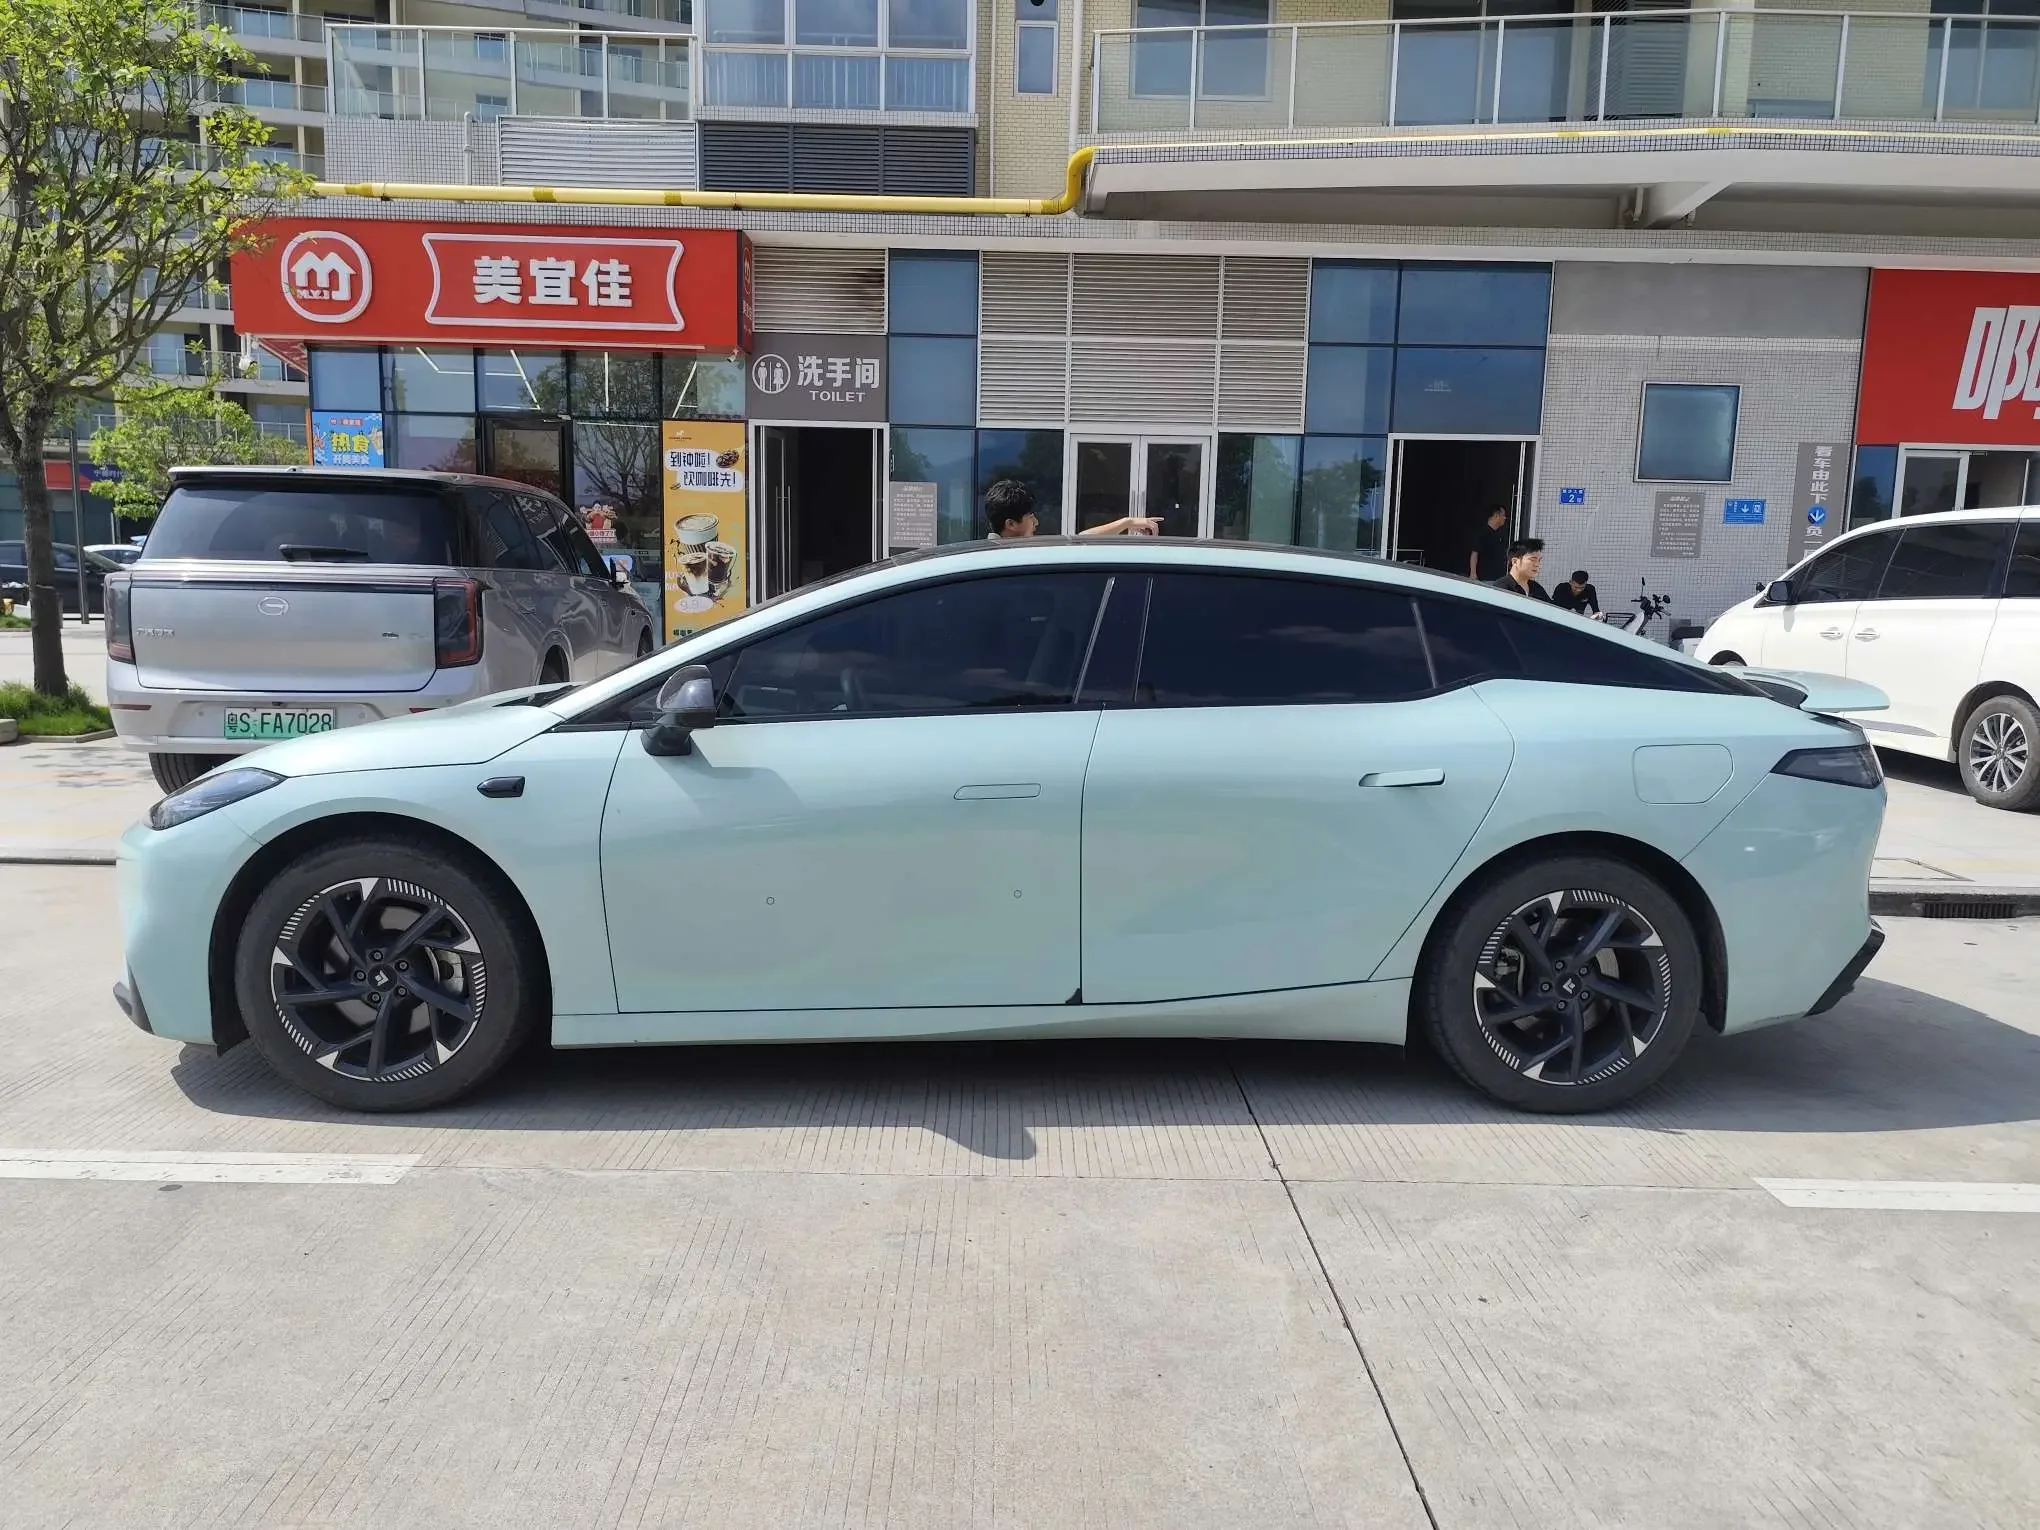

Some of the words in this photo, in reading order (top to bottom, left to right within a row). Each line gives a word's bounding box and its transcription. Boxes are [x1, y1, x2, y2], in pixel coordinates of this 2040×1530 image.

[472, 255, 633, 308] 美宜佳
[797, 355, 880, 389] 洗手间
[809, 390, 866, 402] TOILET
[331, 432, 370, 454] 热食
[1809, 445, 1833, 504] 看车由此下
